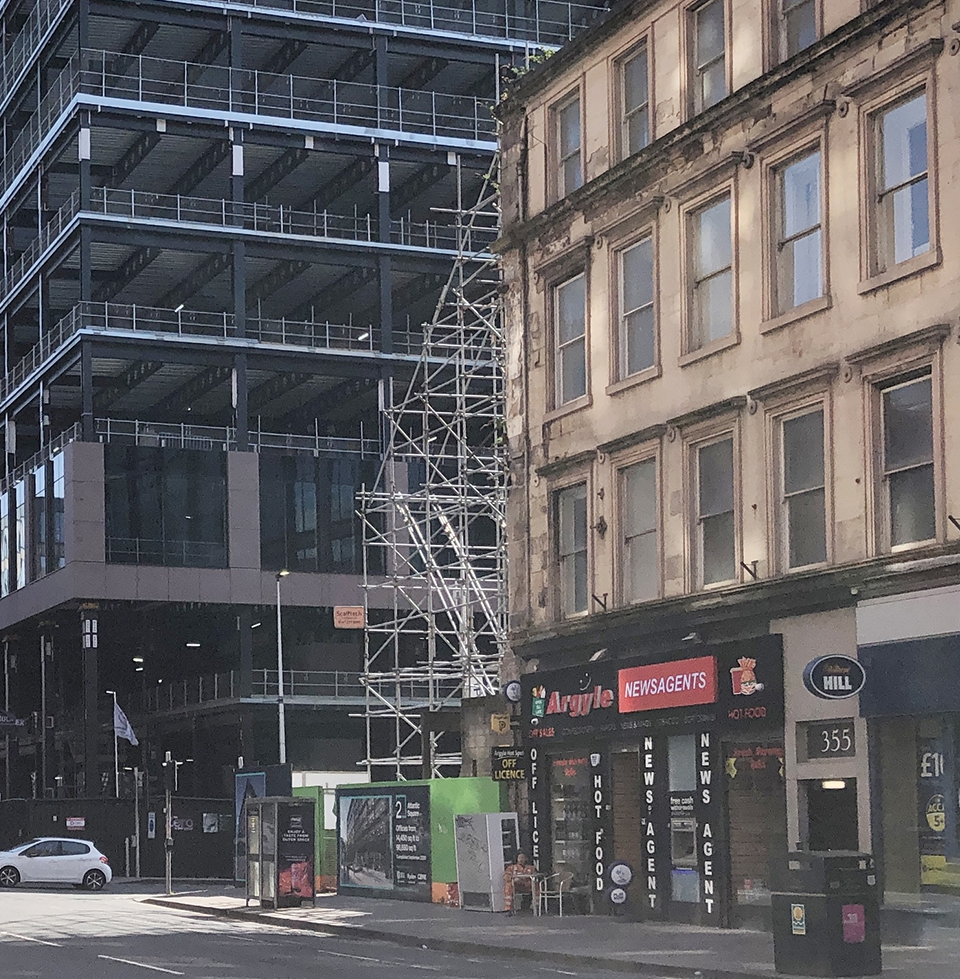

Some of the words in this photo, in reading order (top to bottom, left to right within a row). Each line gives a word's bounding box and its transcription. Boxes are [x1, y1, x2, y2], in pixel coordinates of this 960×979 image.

[546, 685, 614, 717] Argyle
[625, 672, 707, 698] NEWSAGENTS
[823, 676, 852, 690] HILL
[821, 729, 851, 752] 355
[494, 769, 525, 780] LICENCE
[502, 759, 516, 769] OFF
[530, 748, 538, 789] OFF
[644, 737, 654, 804] NEWS
[700, 733, 711, 804] NEWS
[395, 801, 402, 819] 2
[594, 775, 602, 818] HOT
[670, 796, 680, 805] free
[681, 796, 693, 805] cash
[532, 802, 540, 873] LICEN
[595, 831, 603, 891] FOOD
[646, 822, 656, 908] AGENT
[702, 823, 714, 914] AGENT
